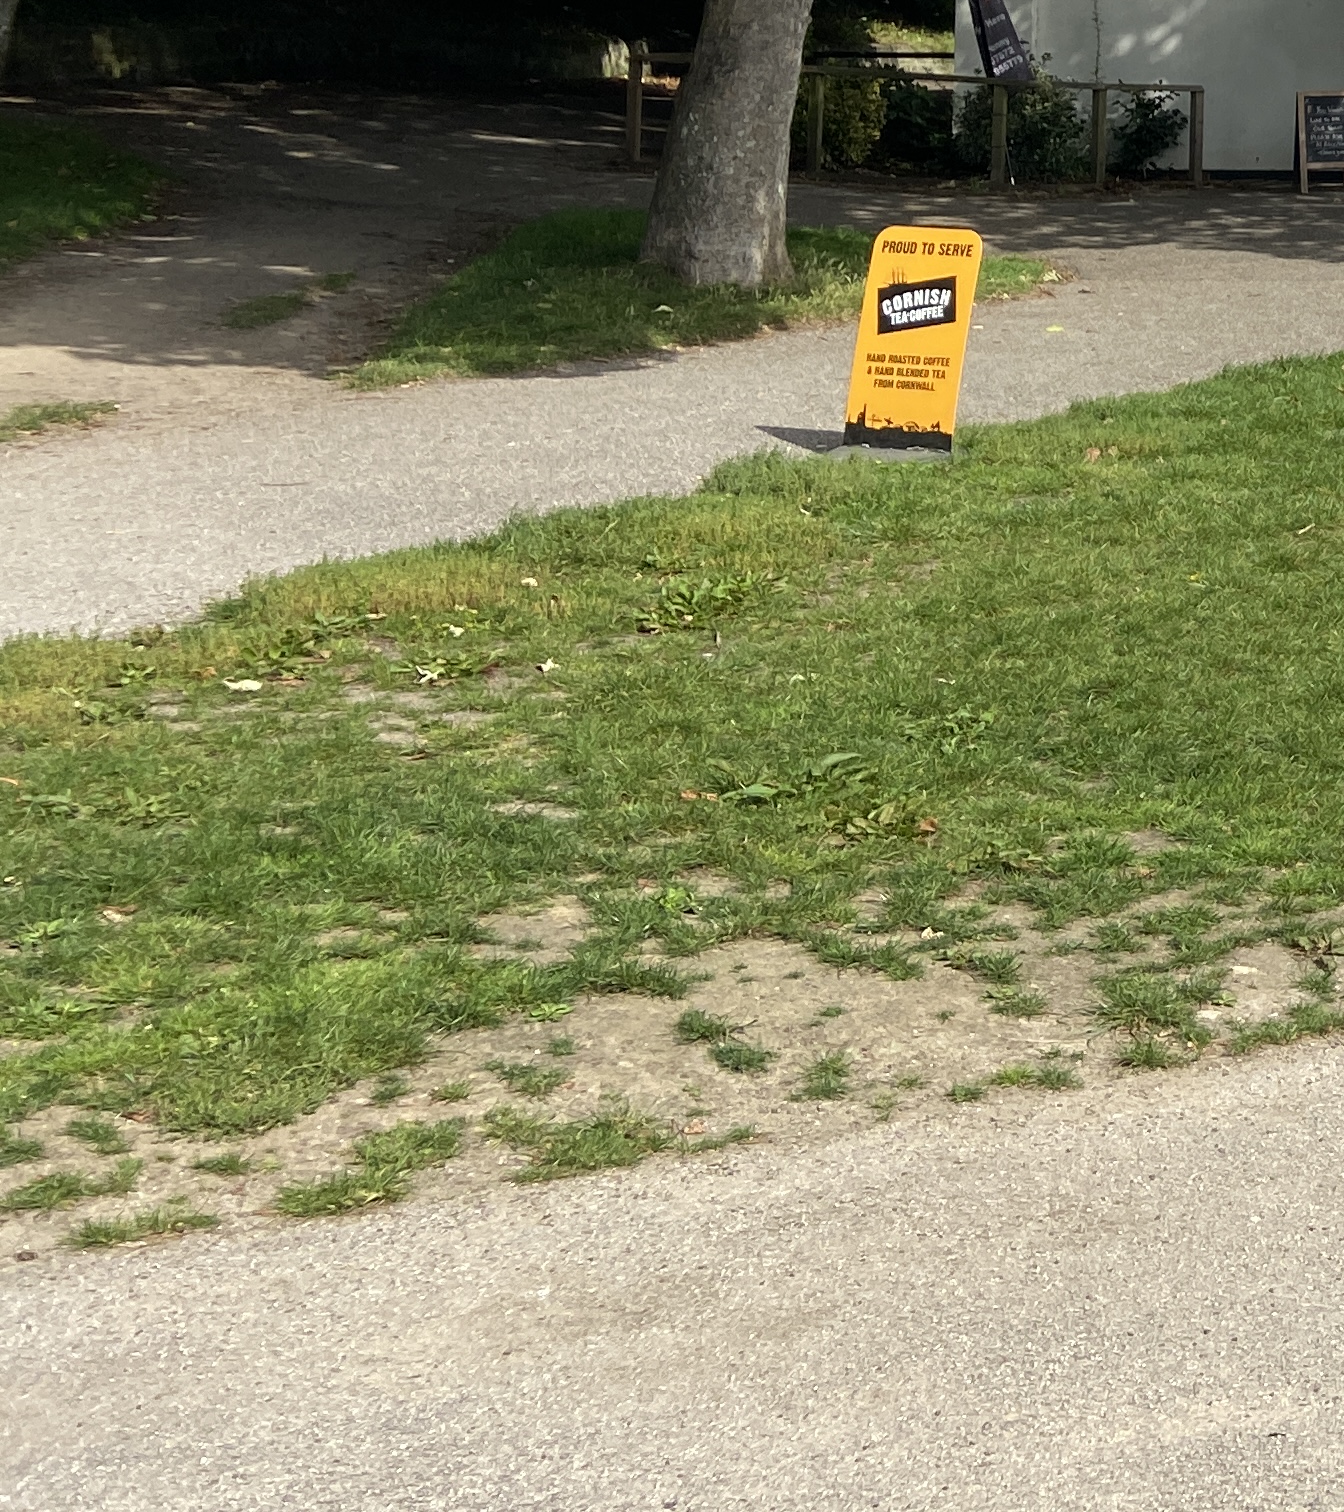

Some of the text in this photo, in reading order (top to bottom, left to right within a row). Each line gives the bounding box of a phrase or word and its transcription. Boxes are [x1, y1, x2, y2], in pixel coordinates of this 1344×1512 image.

[882, 240, 974, 257] PROUD TO SERVE
[882, 289, 952, 316] CORNISH
[866, 353, 950, 367] HAND ROASTED COFFEE
[874, 366, 894, 376] HAND
[897, 368, 929, 378] BLENDED
[932, 369, 946, 379] TEA
[873, 379, 936, 391] FROM CORNWALL
